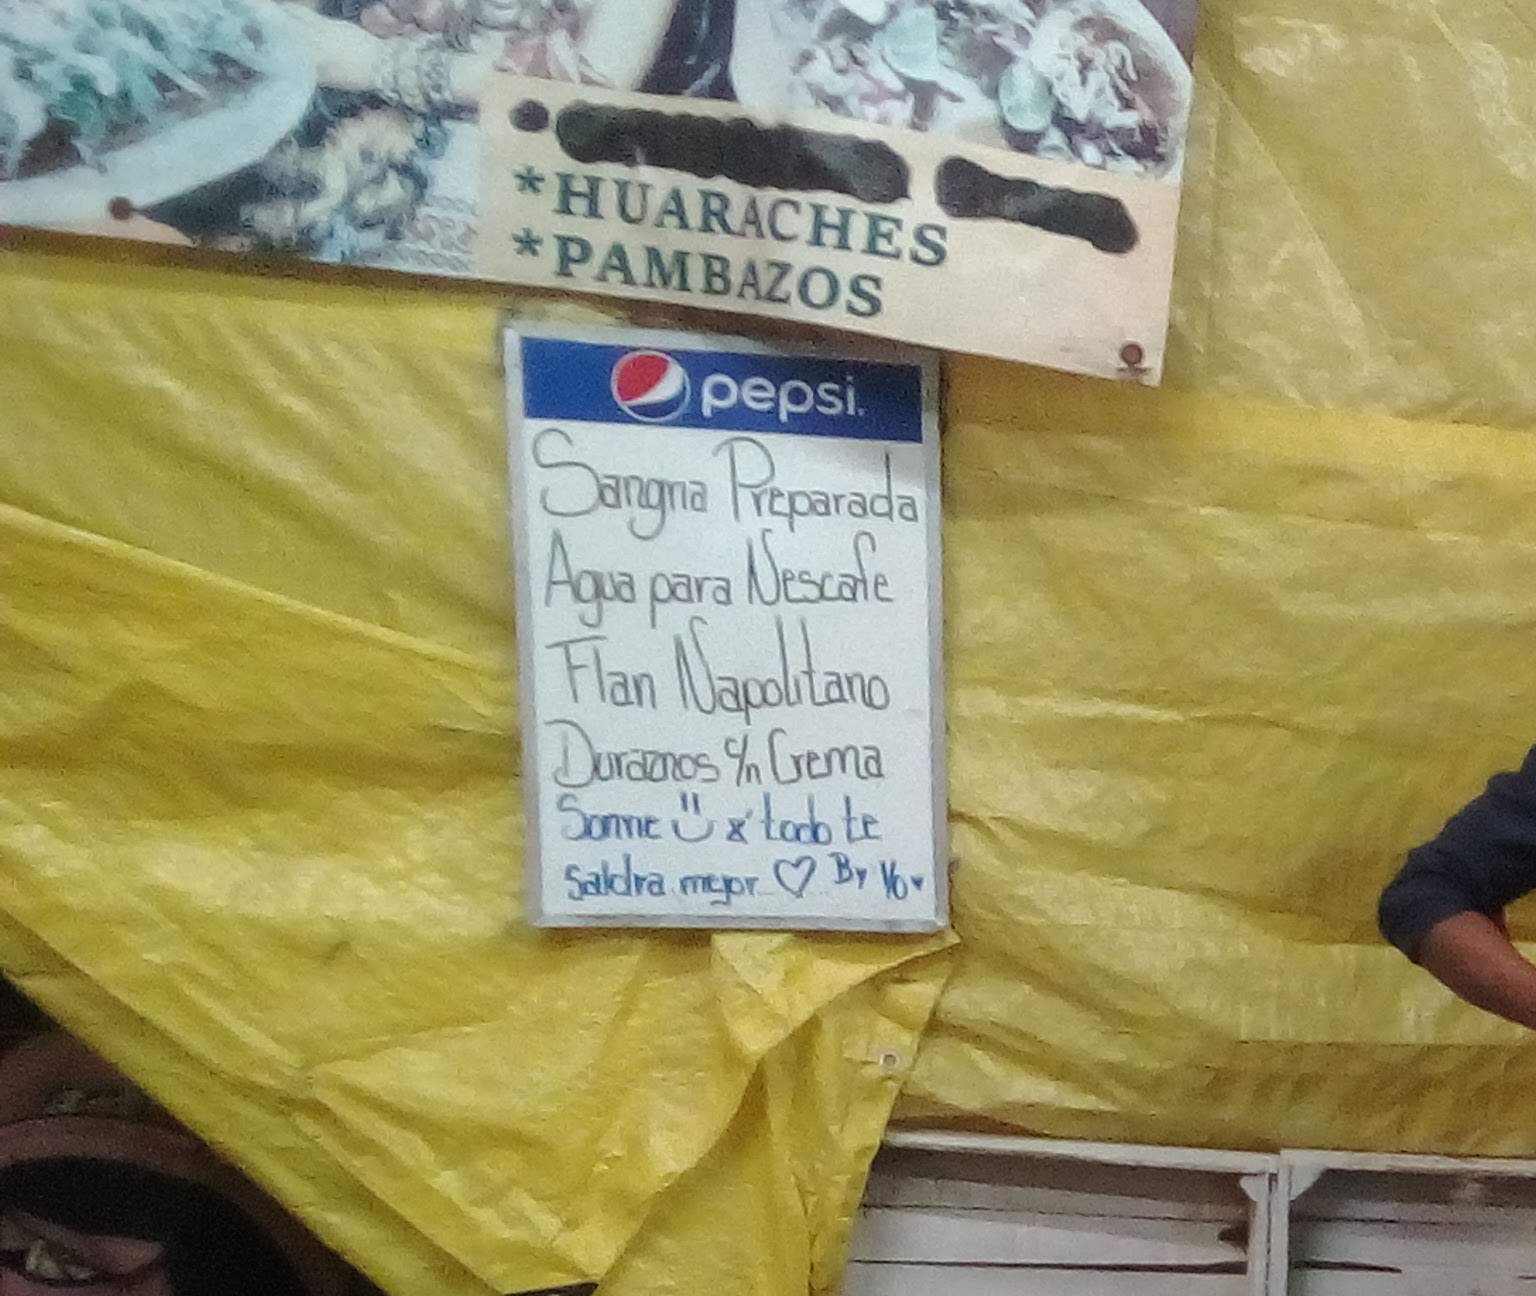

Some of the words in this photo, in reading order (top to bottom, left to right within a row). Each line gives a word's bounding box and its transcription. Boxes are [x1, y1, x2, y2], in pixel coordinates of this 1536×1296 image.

[552, 171, 948, 268] HUARACHES
[552, 234, 883, 318] PAMBAZOS
[701, 373, 865, 422] pepsi
[712, 436, 919, 533] Preparada
[543, 529, 636, 629] Agua
[649, 570, 732, 630] para
[747, 528, 894, 607] Nescafe
[545, 636, 657, 709] Flan
[673, 615, 890, 726] Napolitano
[768, 728, 885, 785] Crema
[760, 791, 833, 845] todo
[842, 795, 883, 843] te
[679, 872, 760, 906] mejor
[827, 851, 868, 890] By
